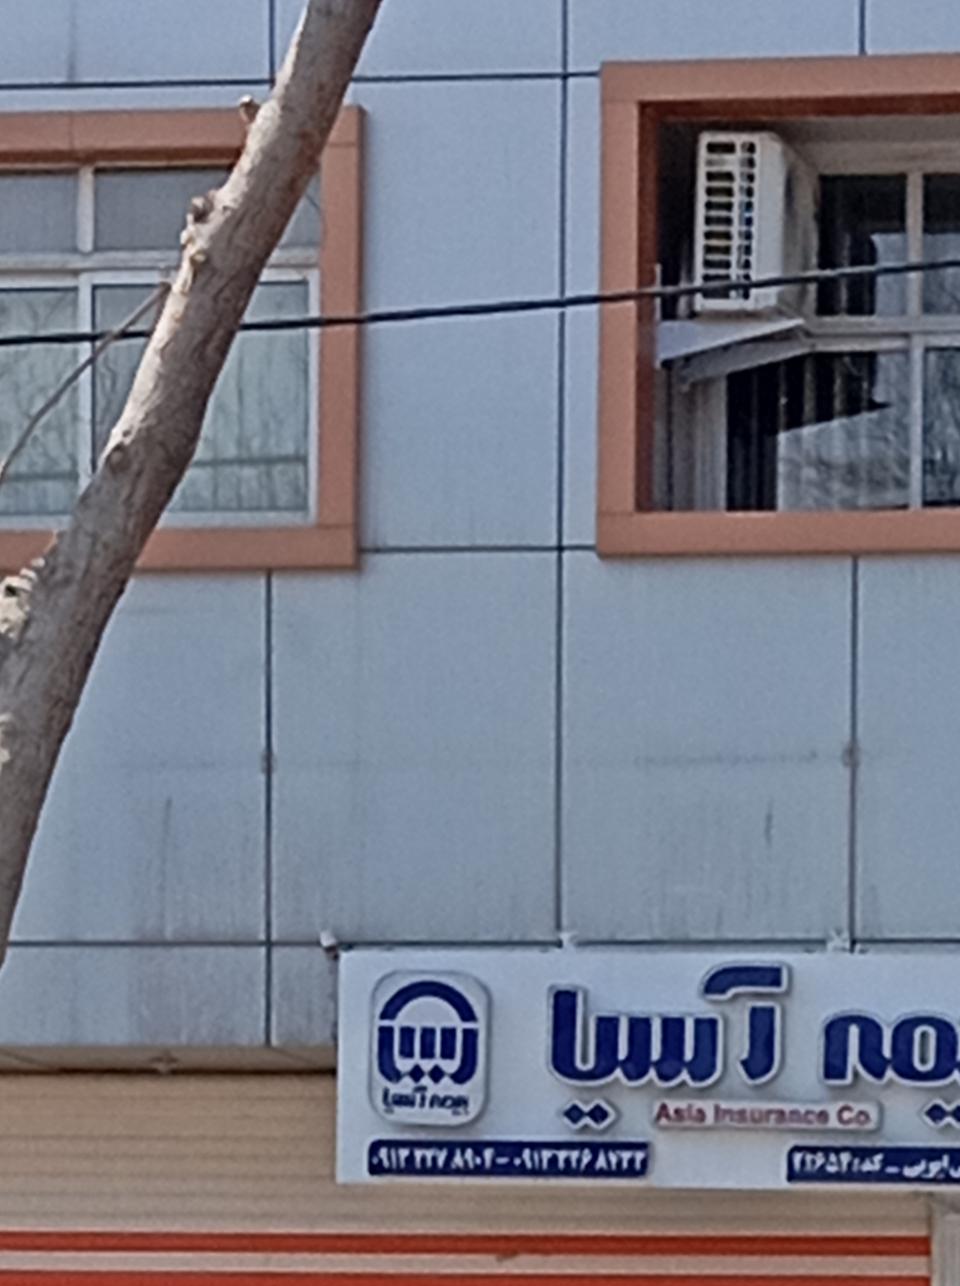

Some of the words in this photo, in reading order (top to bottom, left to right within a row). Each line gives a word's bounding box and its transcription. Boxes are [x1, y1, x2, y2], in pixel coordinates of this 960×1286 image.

[550, 964, 788, 1128] آسیا
[655, 1102, 707, 1123] Asia
[713, 1103, 830, 1125] Insurance
